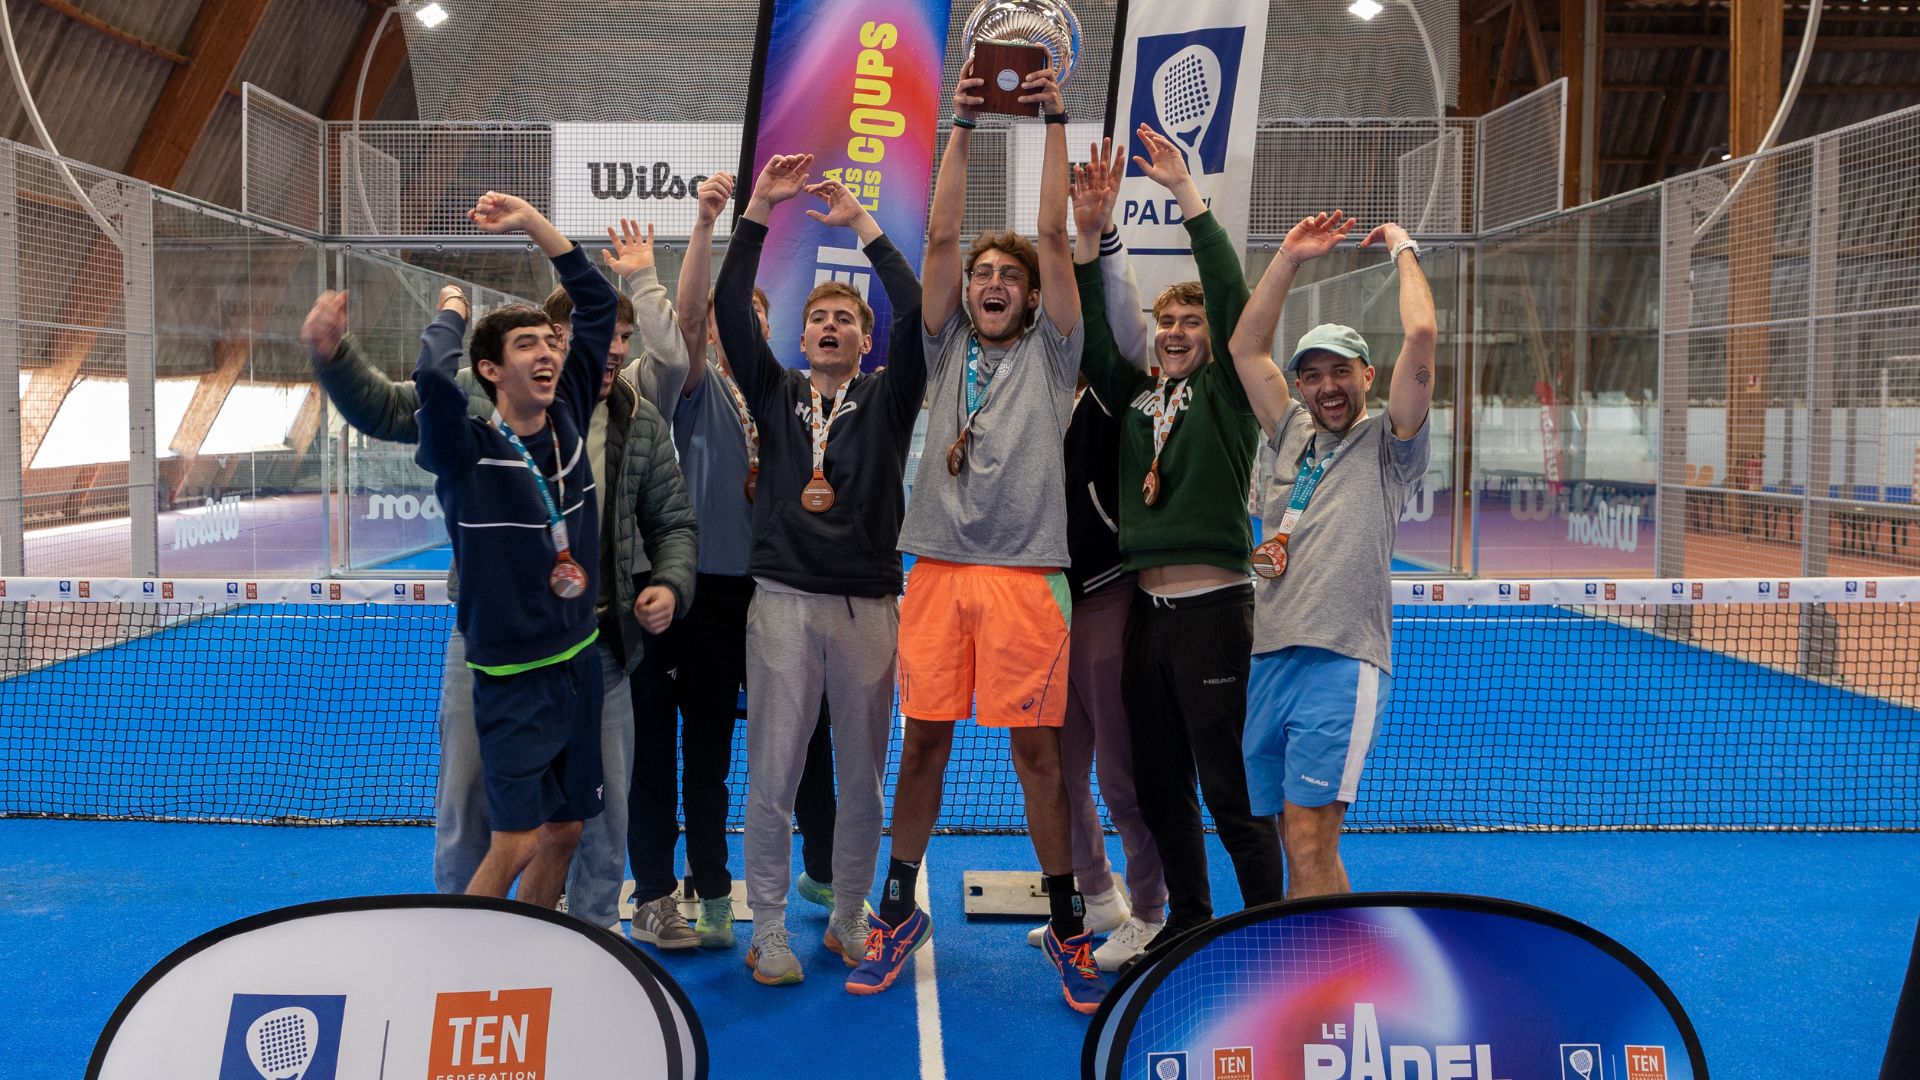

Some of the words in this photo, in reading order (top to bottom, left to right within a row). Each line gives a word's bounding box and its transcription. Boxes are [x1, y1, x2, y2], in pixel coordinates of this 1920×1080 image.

[847, 21, 905, 164] COUPS
[862, 170, 881, 211] LES
[1203, 676, 1236, 685] HEAD
[1301, 774, 1329, 787] HEAD
[1322, 1023, 1346, 1039] LE
[448, 1014, 529, 1066] TEN
[1304, 1003, 1512, 1080] PADEL
[1219, 1056, 1246, 1073] TEN
[1632, 1055, 1659, 1071] TEN
